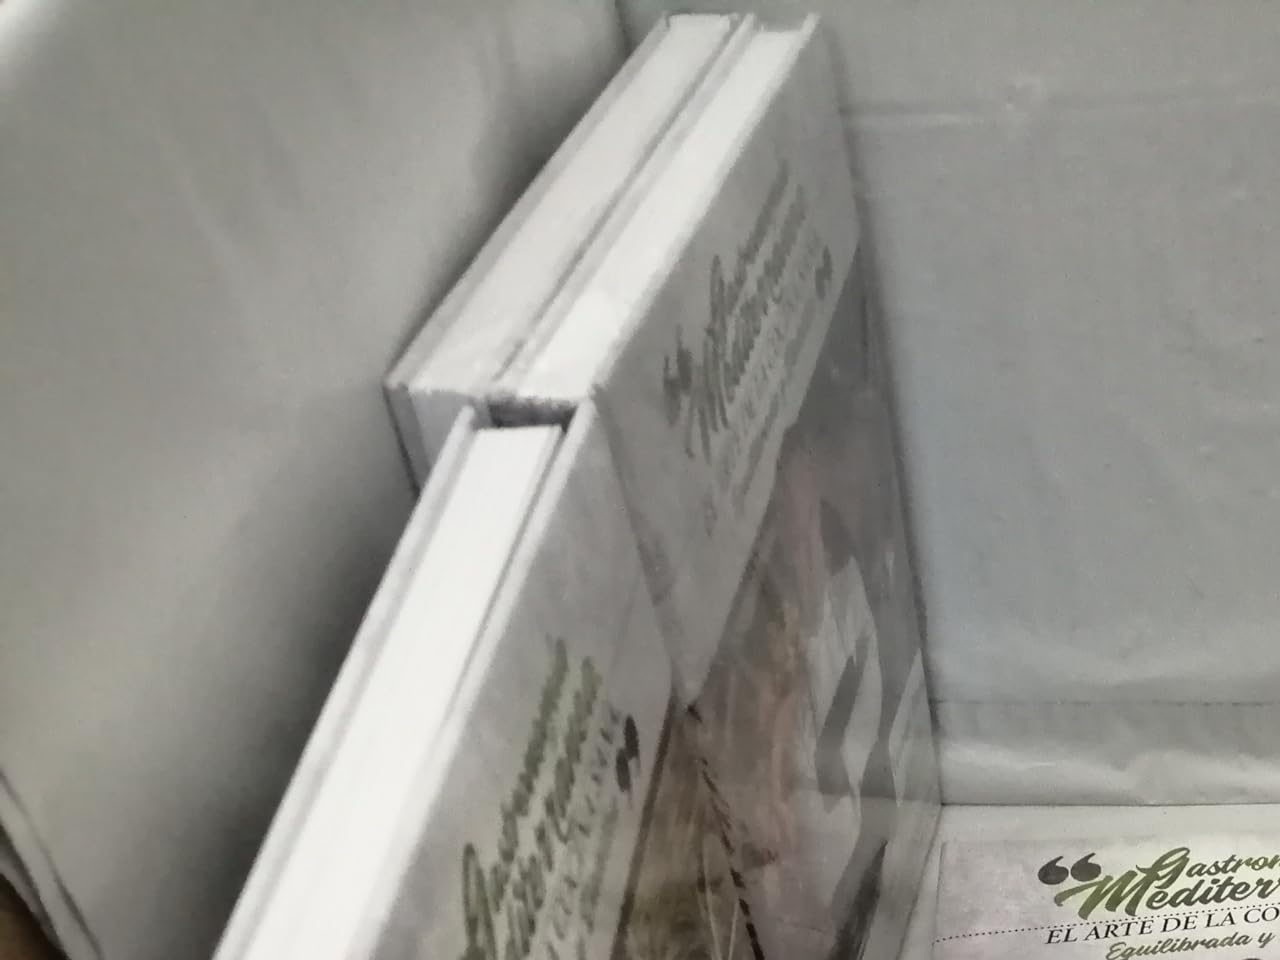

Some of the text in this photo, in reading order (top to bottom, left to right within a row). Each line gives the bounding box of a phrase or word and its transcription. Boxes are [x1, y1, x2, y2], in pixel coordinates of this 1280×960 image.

[1045, 928, 1077, 945] EL
[1083, 920, 1154, 941] ARTE
[1160, 915, 1198, 933] DE
[1205, 911, 1236, 929] LA
[1258, 932, 1275, 949] y
